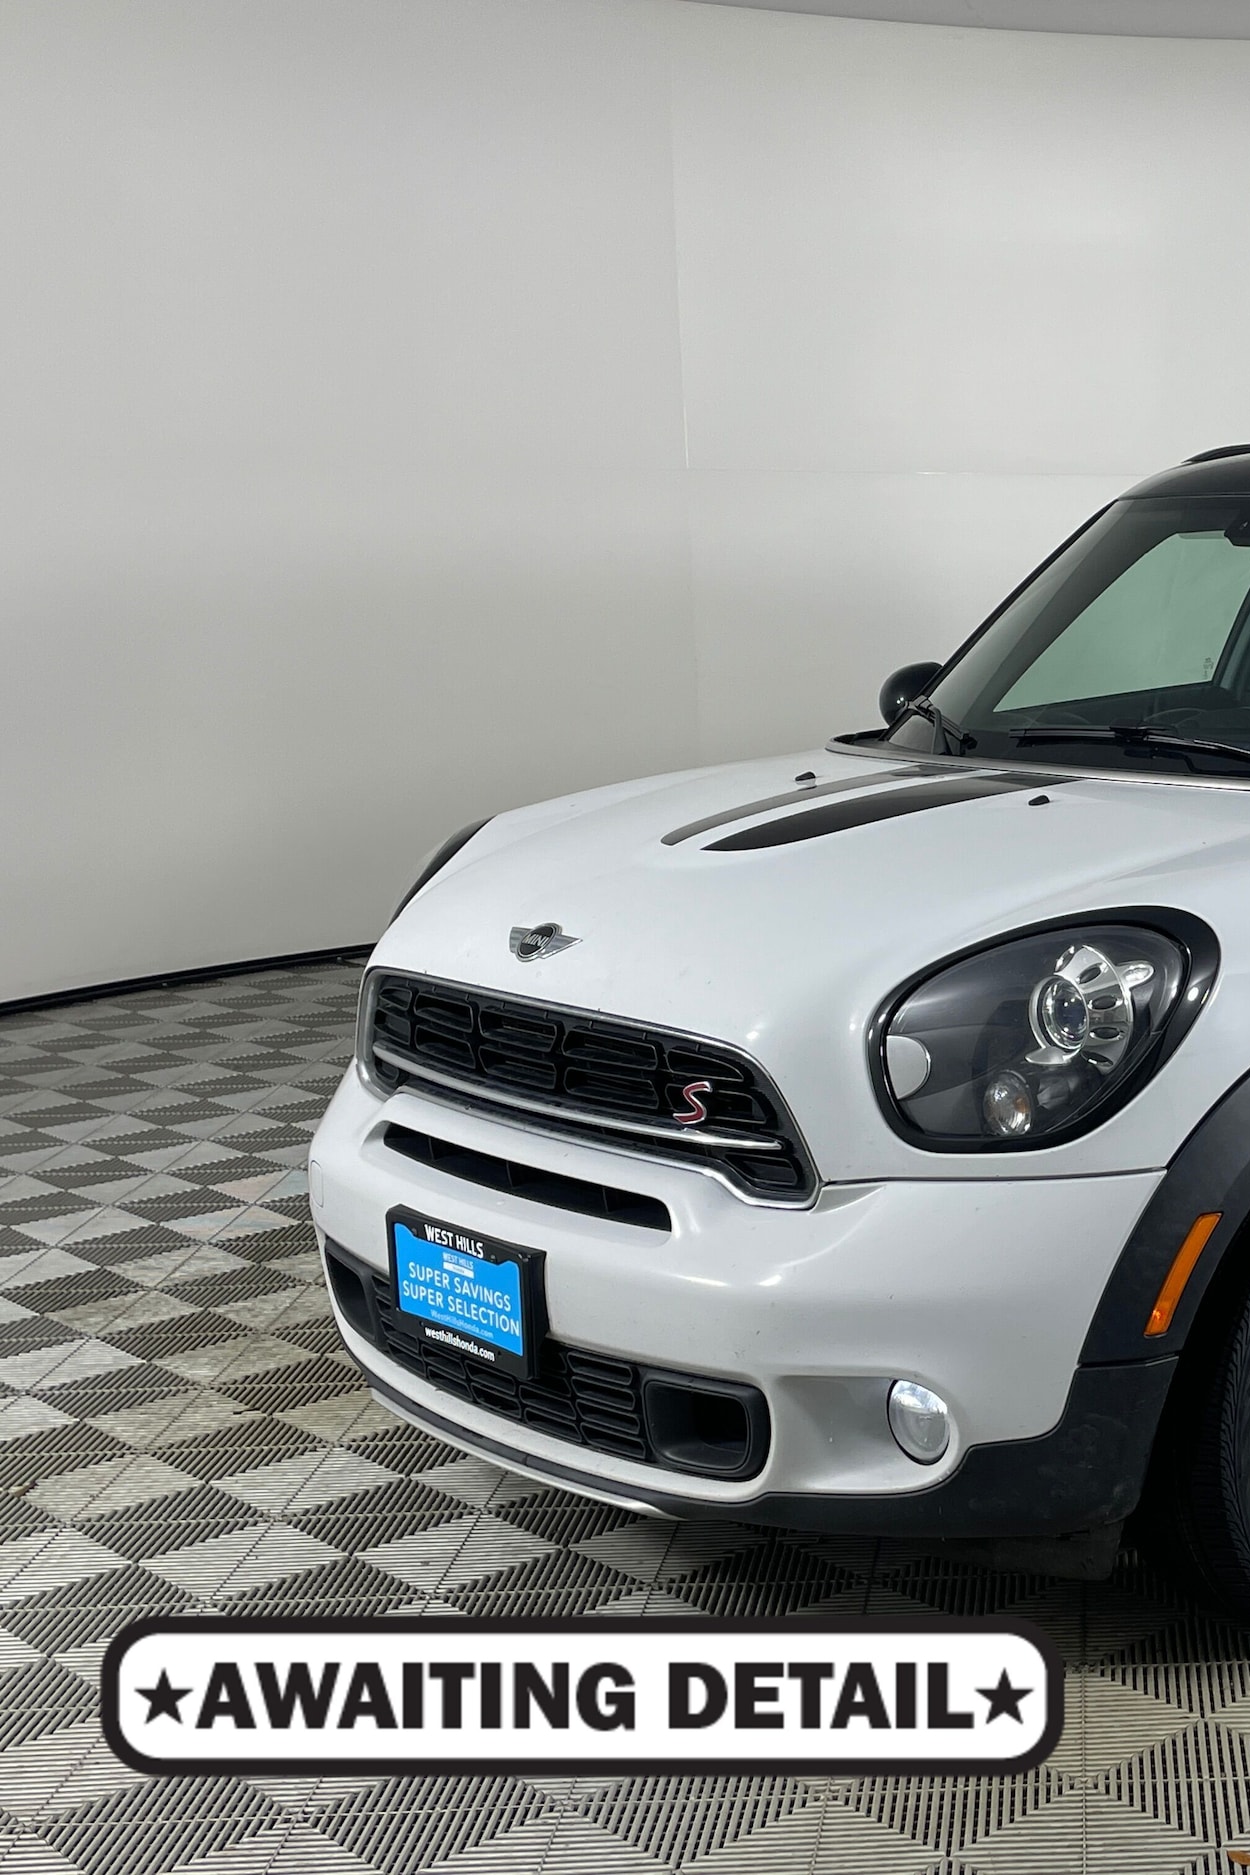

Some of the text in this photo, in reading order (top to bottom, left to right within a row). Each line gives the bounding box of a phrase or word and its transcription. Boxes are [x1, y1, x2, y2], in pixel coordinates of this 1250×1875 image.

[673, 1081, 713, 1124] S
[424, 1223, 484, 1259] WEST HILLS
[408, 1261, 512, 1312] SUPER SAVINGS
[402, 1280, 520, 1337] SUPER SELECTION
[424, 1327, 496, 1362] westhillshonda.com
